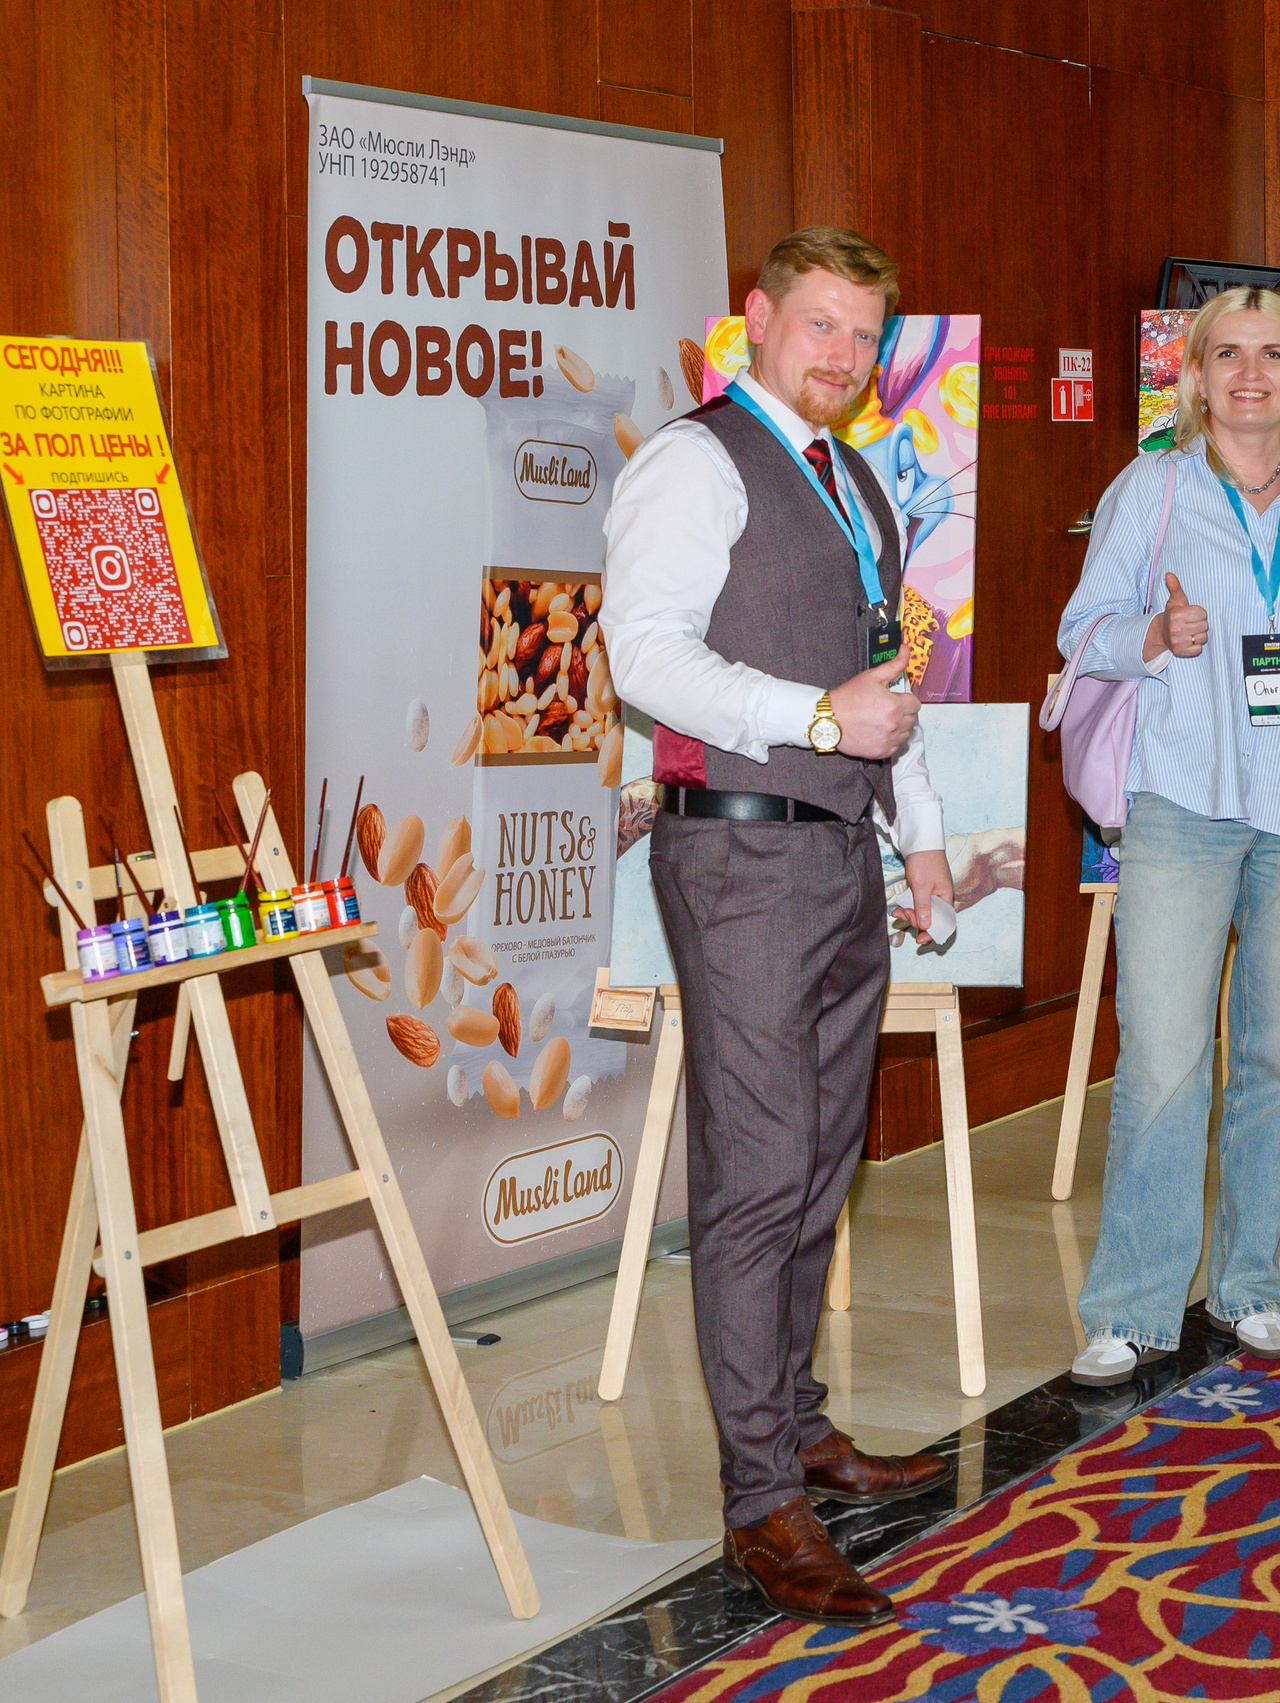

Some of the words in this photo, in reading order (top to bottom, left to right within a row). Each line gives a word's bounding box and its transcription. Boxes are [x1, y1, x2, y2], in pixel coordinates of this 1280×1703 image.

[318, 124, 355, 150] ЗАО
[359, 130, 425, 159] «Мюсли
[428, 139, 477, 169] Лэнд»
[318, 152, 356, 177] УНП
[361, 157, 448, 188] 192958741
[324, 214, 636, 311] ОТКРЫВАЙ
[4, 344, 125, 377] СЕГОДНЯ!!!
[324, 319, 545, 399] НОВОЕ!
[983, 346, 1001, 362] ПРИ
[1002, 347, 1035, 363] ПОЖАРЕ
[1062, 356, 1091, 373] ПК-22
[992, 366, 1028, 381] ЗВОНИТЬ
[39, 383, 105, 399] КАРТИНА
[1003, 385, 1017, 400] 101
[15, 405, 37, 420] ПО
[40, 405, 135, 422] ФОТОГРАФИИ
[983, 404, 1000, 419] FIRE
[1002, 404, 1038, 419] HYDRANT
[0, 432, 32, 457] ЗА
[34, 433, 86, 458] ПОЛ
[90, 434, 153, 462] ЦЕНЫ
[519, 452, 559, 487] Musli
[560, 458, 591, 489] Land
[873, 649, 898, 664] ПАРТНЕР
[497, 810, 597, 868] NUTS&
[493, 865, 597, 926] HONEY
[491, 940, 523, 953] ОРЕХОВО
[527, 934, 561, 950] МЕДОВЫЙ
[562, 933, 597, 947] БАТОНЧИК
[518, 950, 541, 963] БЕЛОЙ
[541, 948, 576, 961] ГЛАЗУРЬЮ
[493, 1165, 560, 1226] Musli
[563, 1148, 613, 1203] Land
